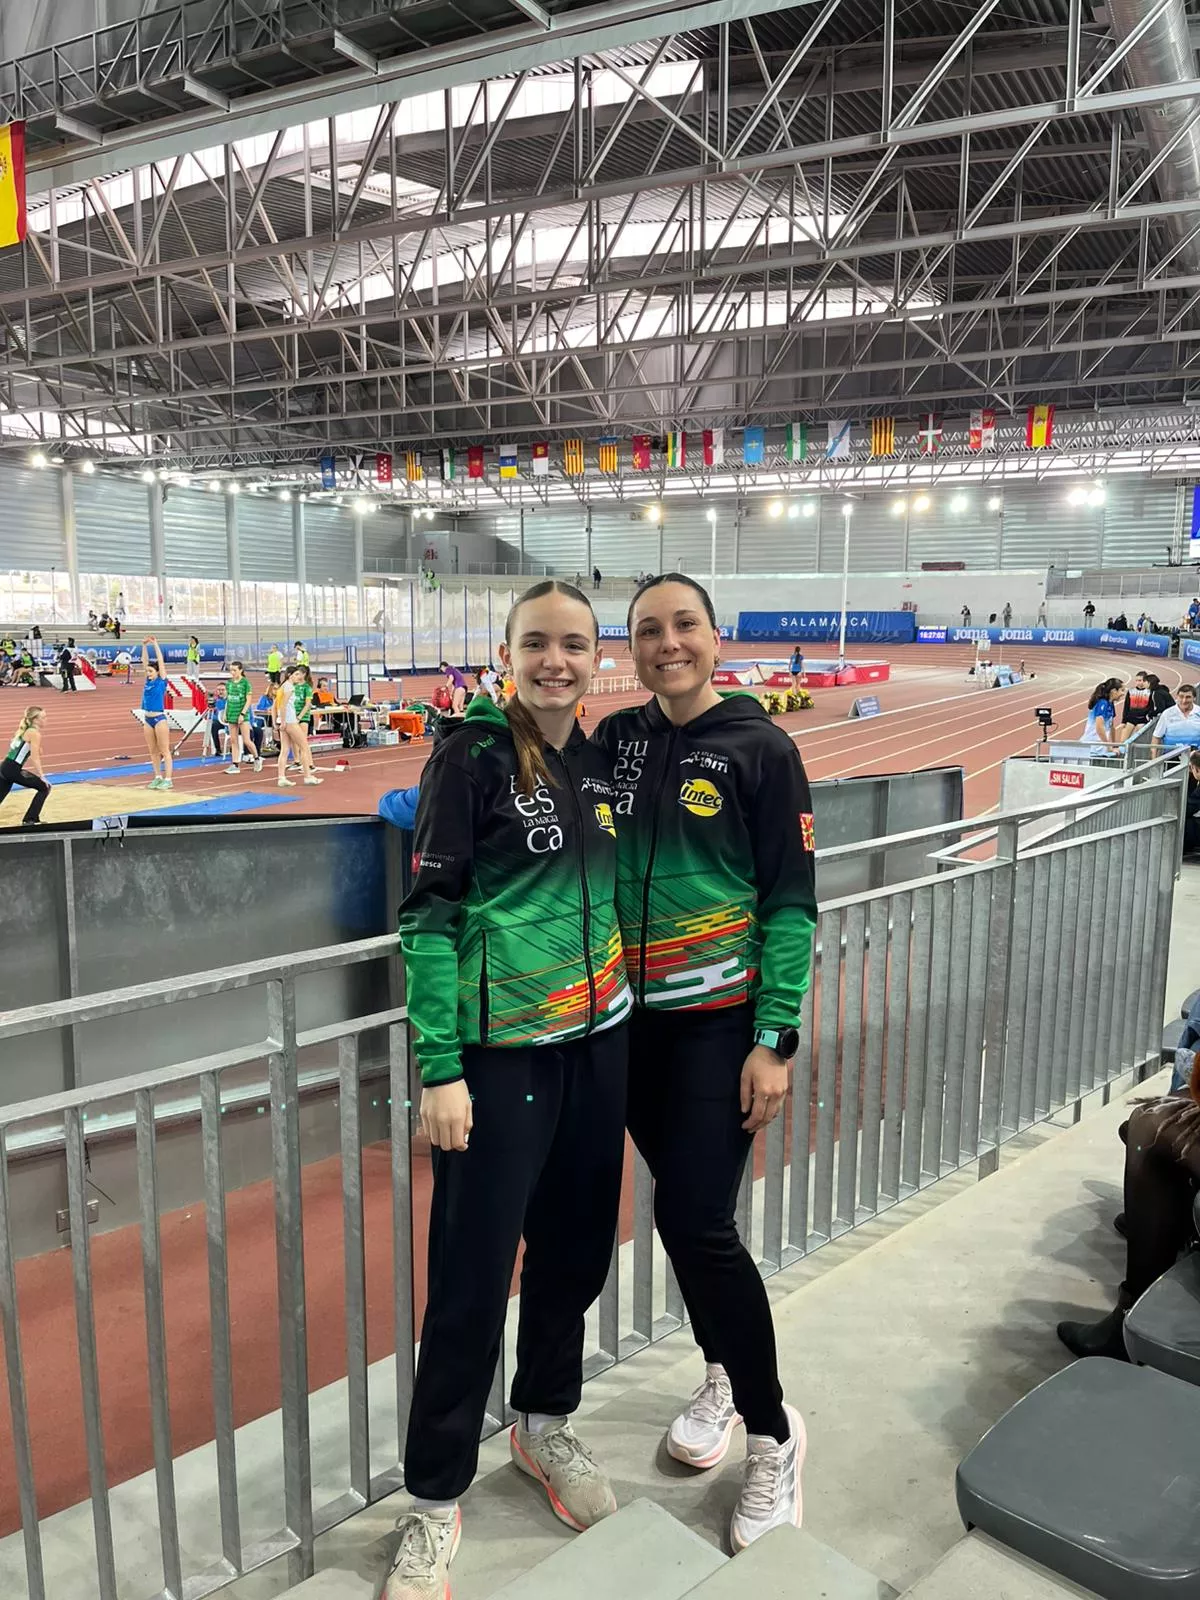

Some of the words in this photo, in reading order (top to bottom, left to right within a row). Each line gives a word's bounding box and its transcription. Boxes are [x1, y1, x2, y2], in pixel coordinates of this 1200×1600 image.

[781, 617, 869, 627] SALAMACA
[613, 757, 644, 781] es
[1061, 773, 1080, 785] SALIDA
[514, 788, 555, 817] es
[526, 824, 563, 854] ca
